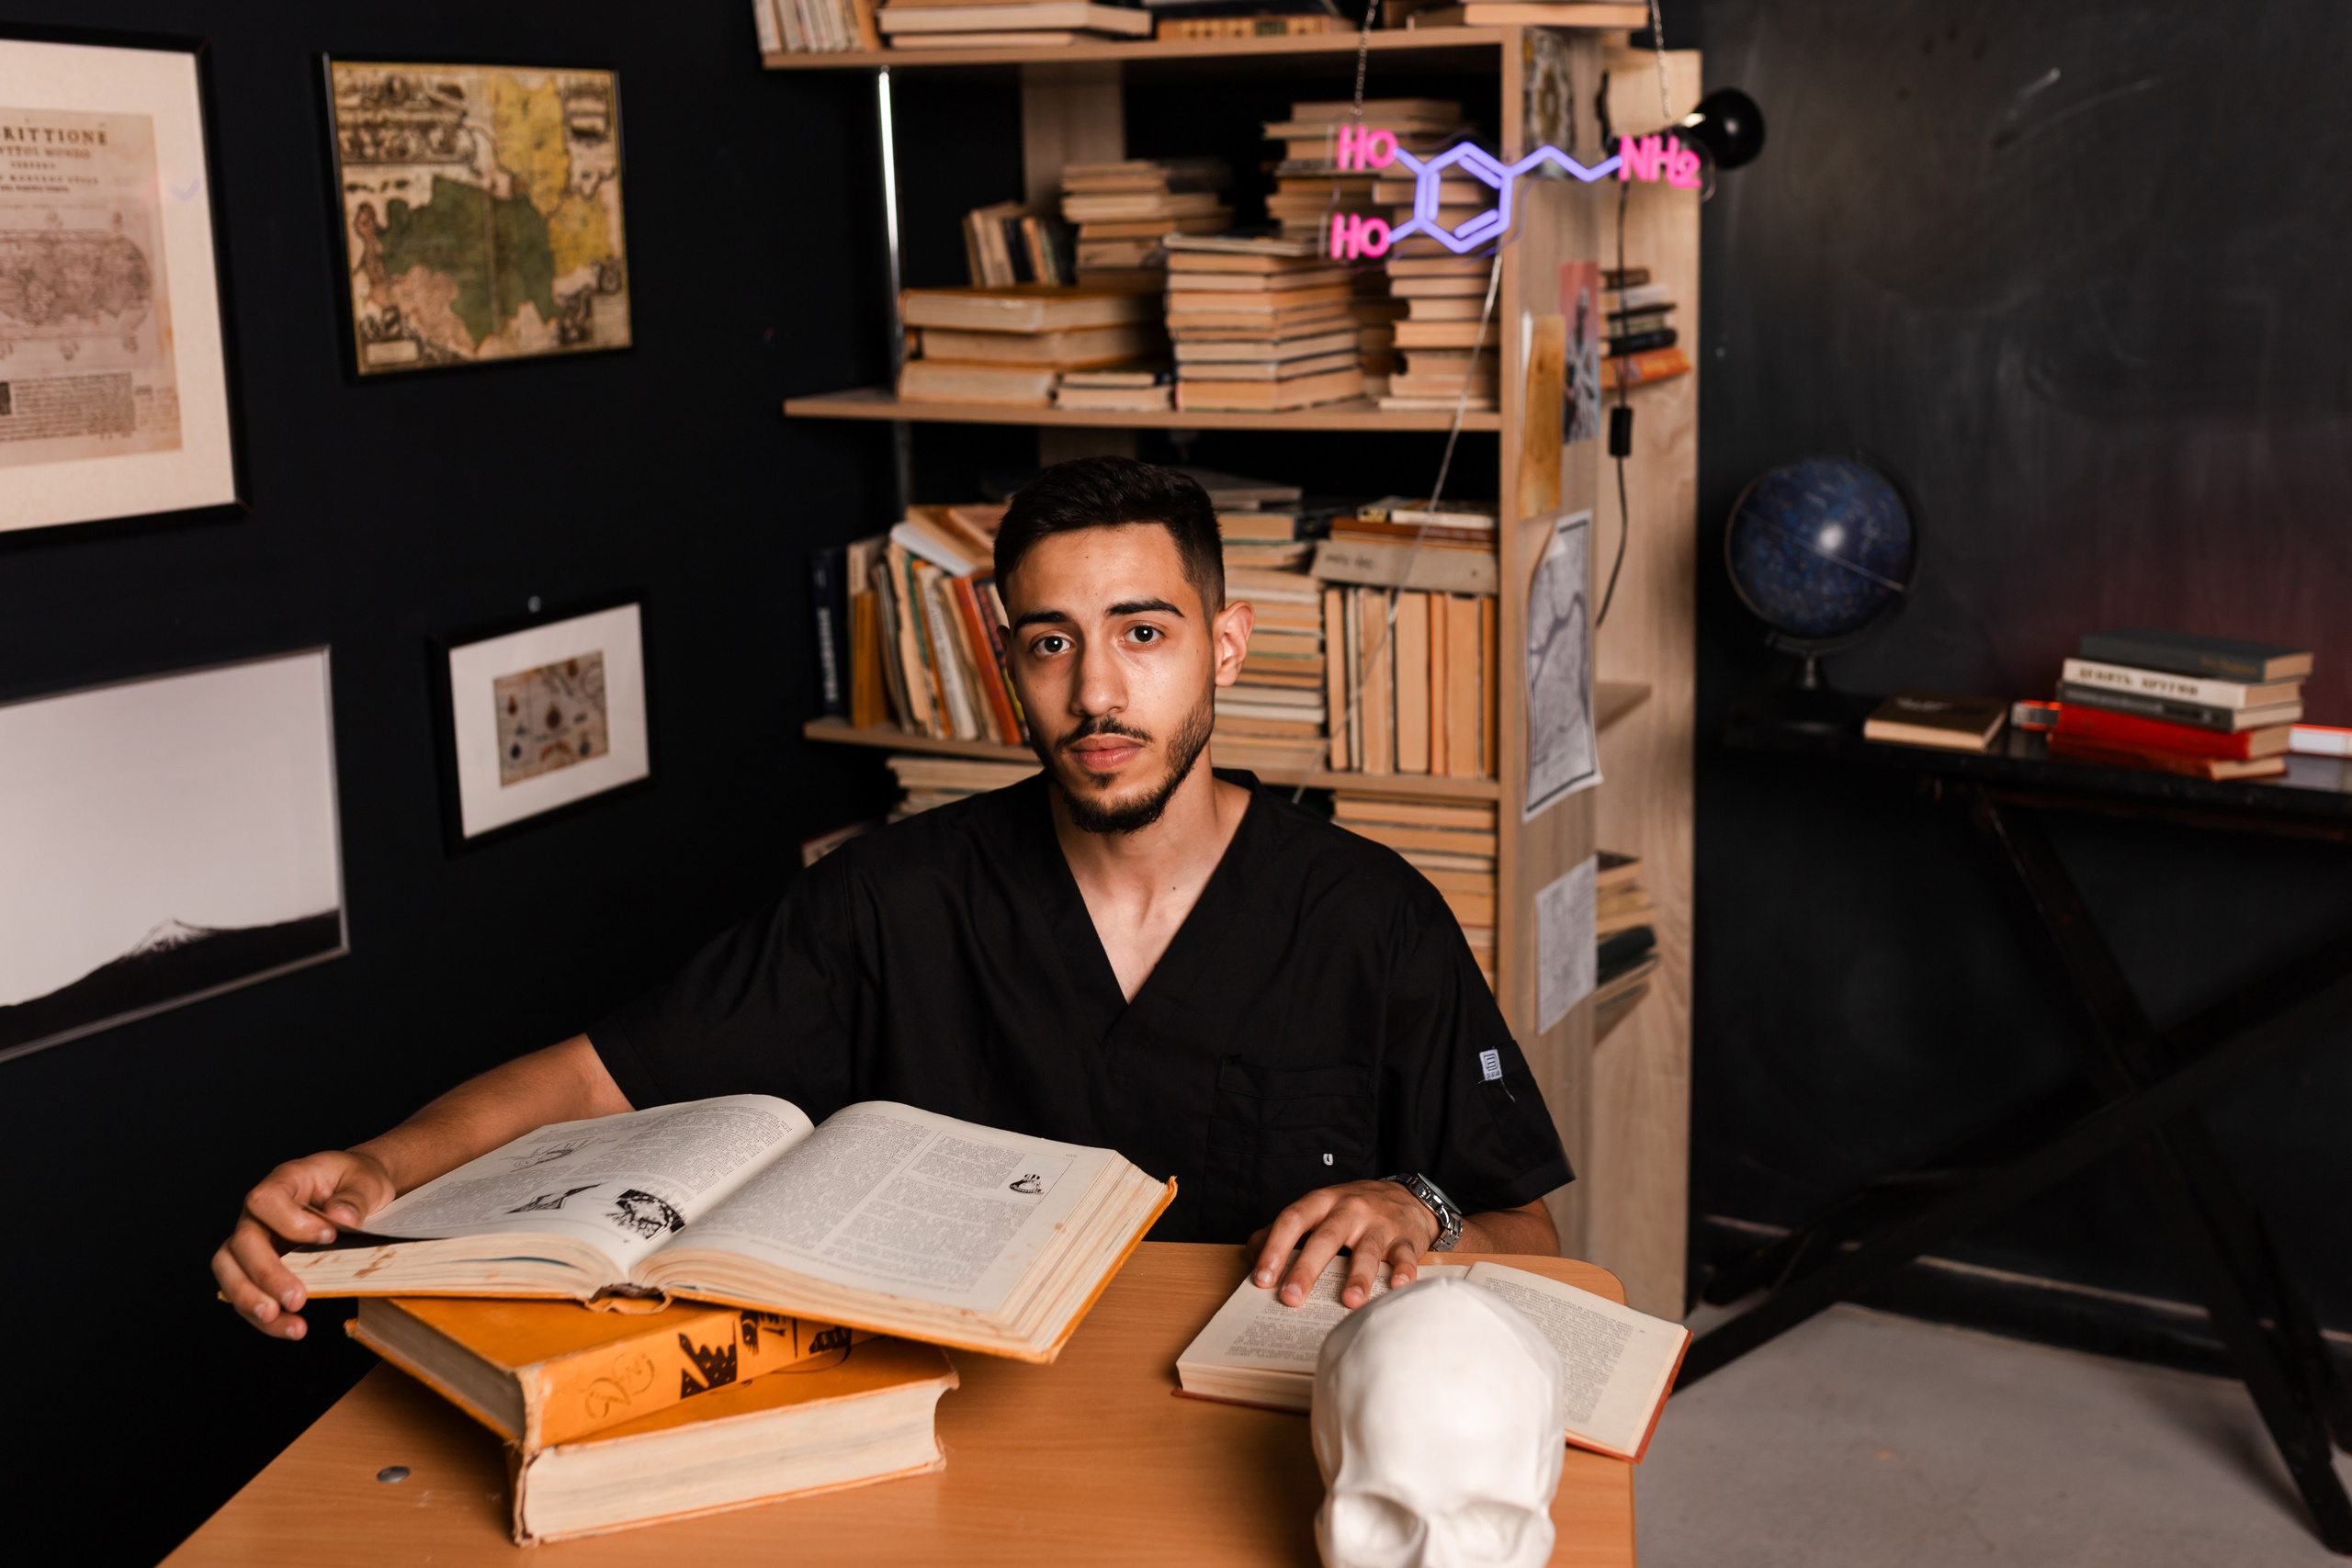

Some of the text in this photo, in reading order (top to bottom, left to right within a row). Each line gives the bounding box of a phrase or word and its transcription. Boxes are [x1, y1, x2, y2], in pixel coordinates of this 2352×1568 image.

[1337, 123, 1398, 172] HO
[1618, 133, 1702, 189] NH2
[1329, 212, 1391, 260] HO
